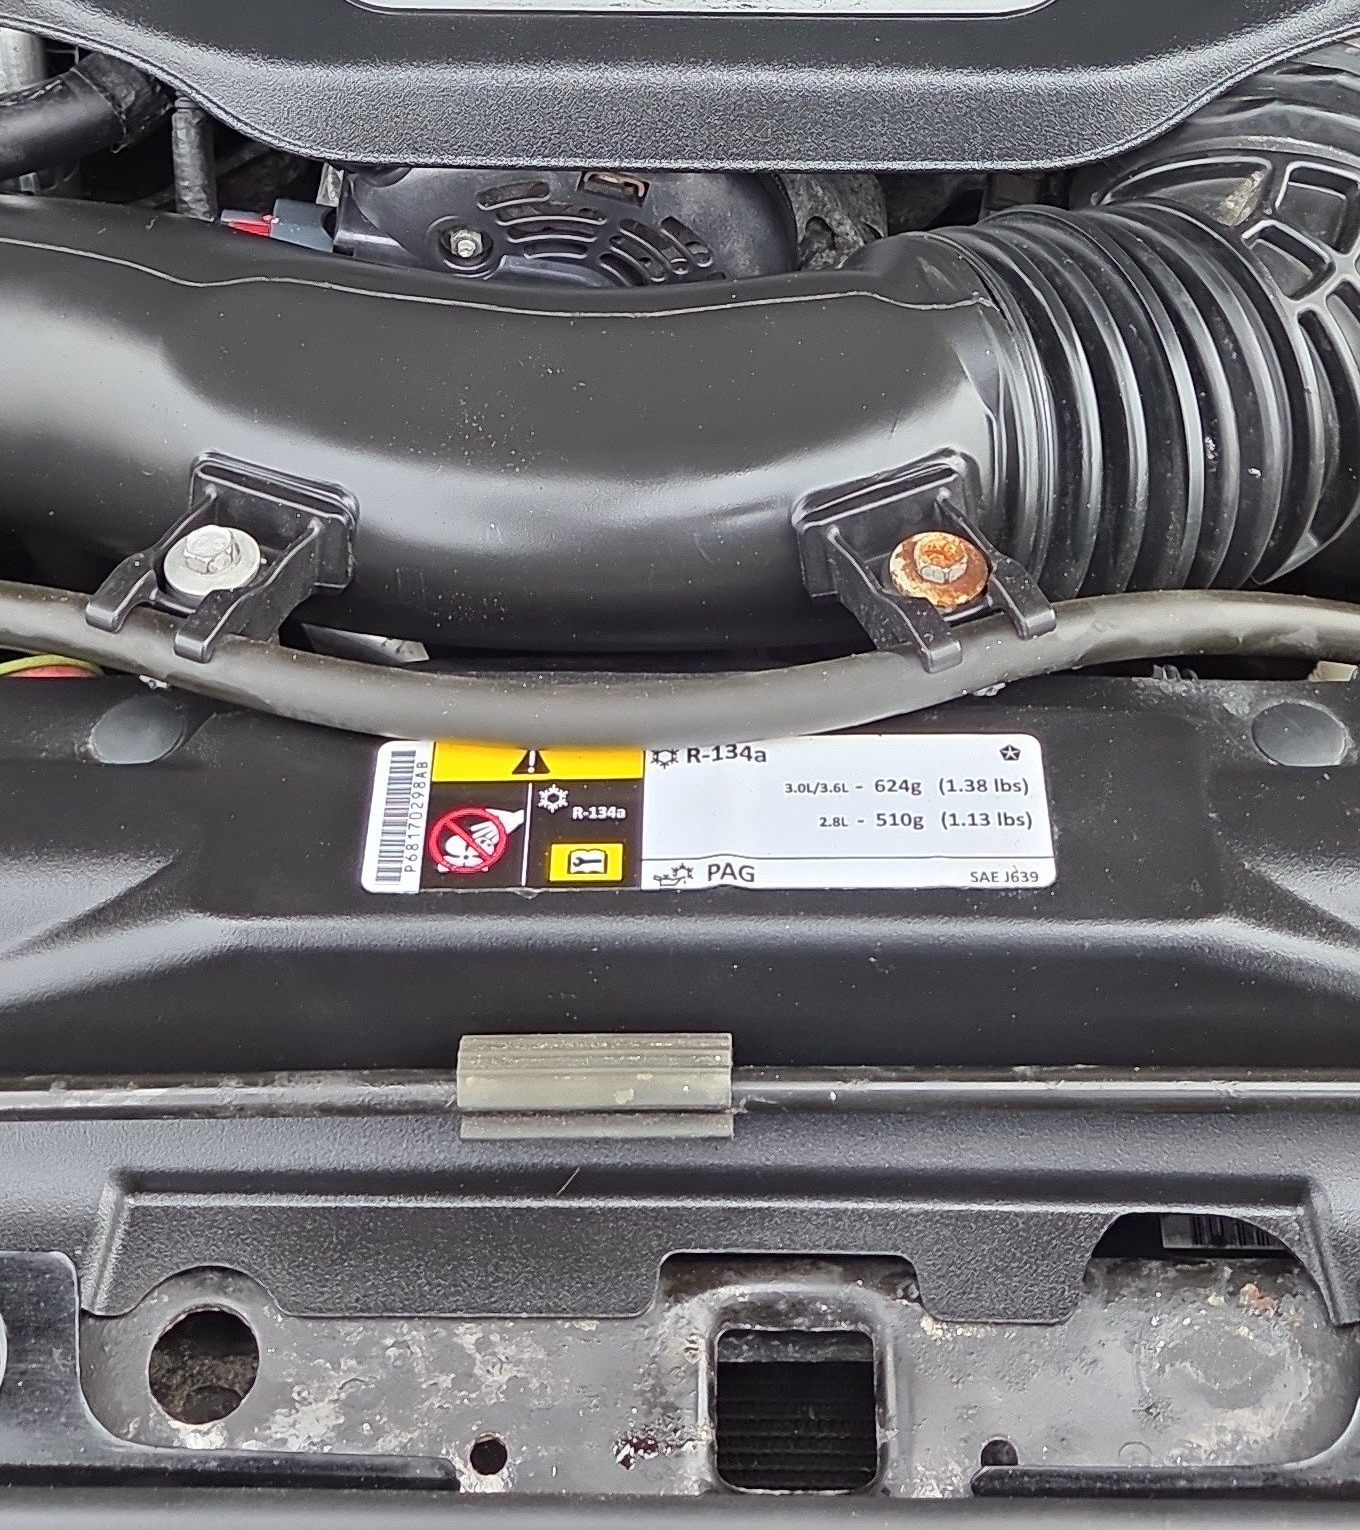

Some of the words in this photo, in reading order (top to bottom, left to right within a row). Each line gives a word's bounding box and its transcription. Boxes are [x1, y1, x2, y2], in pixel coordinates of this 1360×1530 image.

[686, 743, 768, 764] R-134a
[784, 782, 849, 795] 3.0L/3.6L
[874, 778, 922, 796] 624g
[939, 777, 989, 796] (1.38
[994, 777, 1030, 796] lbs)
[403, 760, 429, 874] P68170298AB
[571, 805, 628, 821] R-134a
[819, 816, 849, 828] 2.8L
[875, 812, 925, 830] 510g
[941, 811, 991, 830] (1.13
[997, 811, 1033, 830] lbs)
[707, 862, 756, 883] PAG
[970, 871, 999, 883] SAE
[1004, 870, 1039, 883] J639
